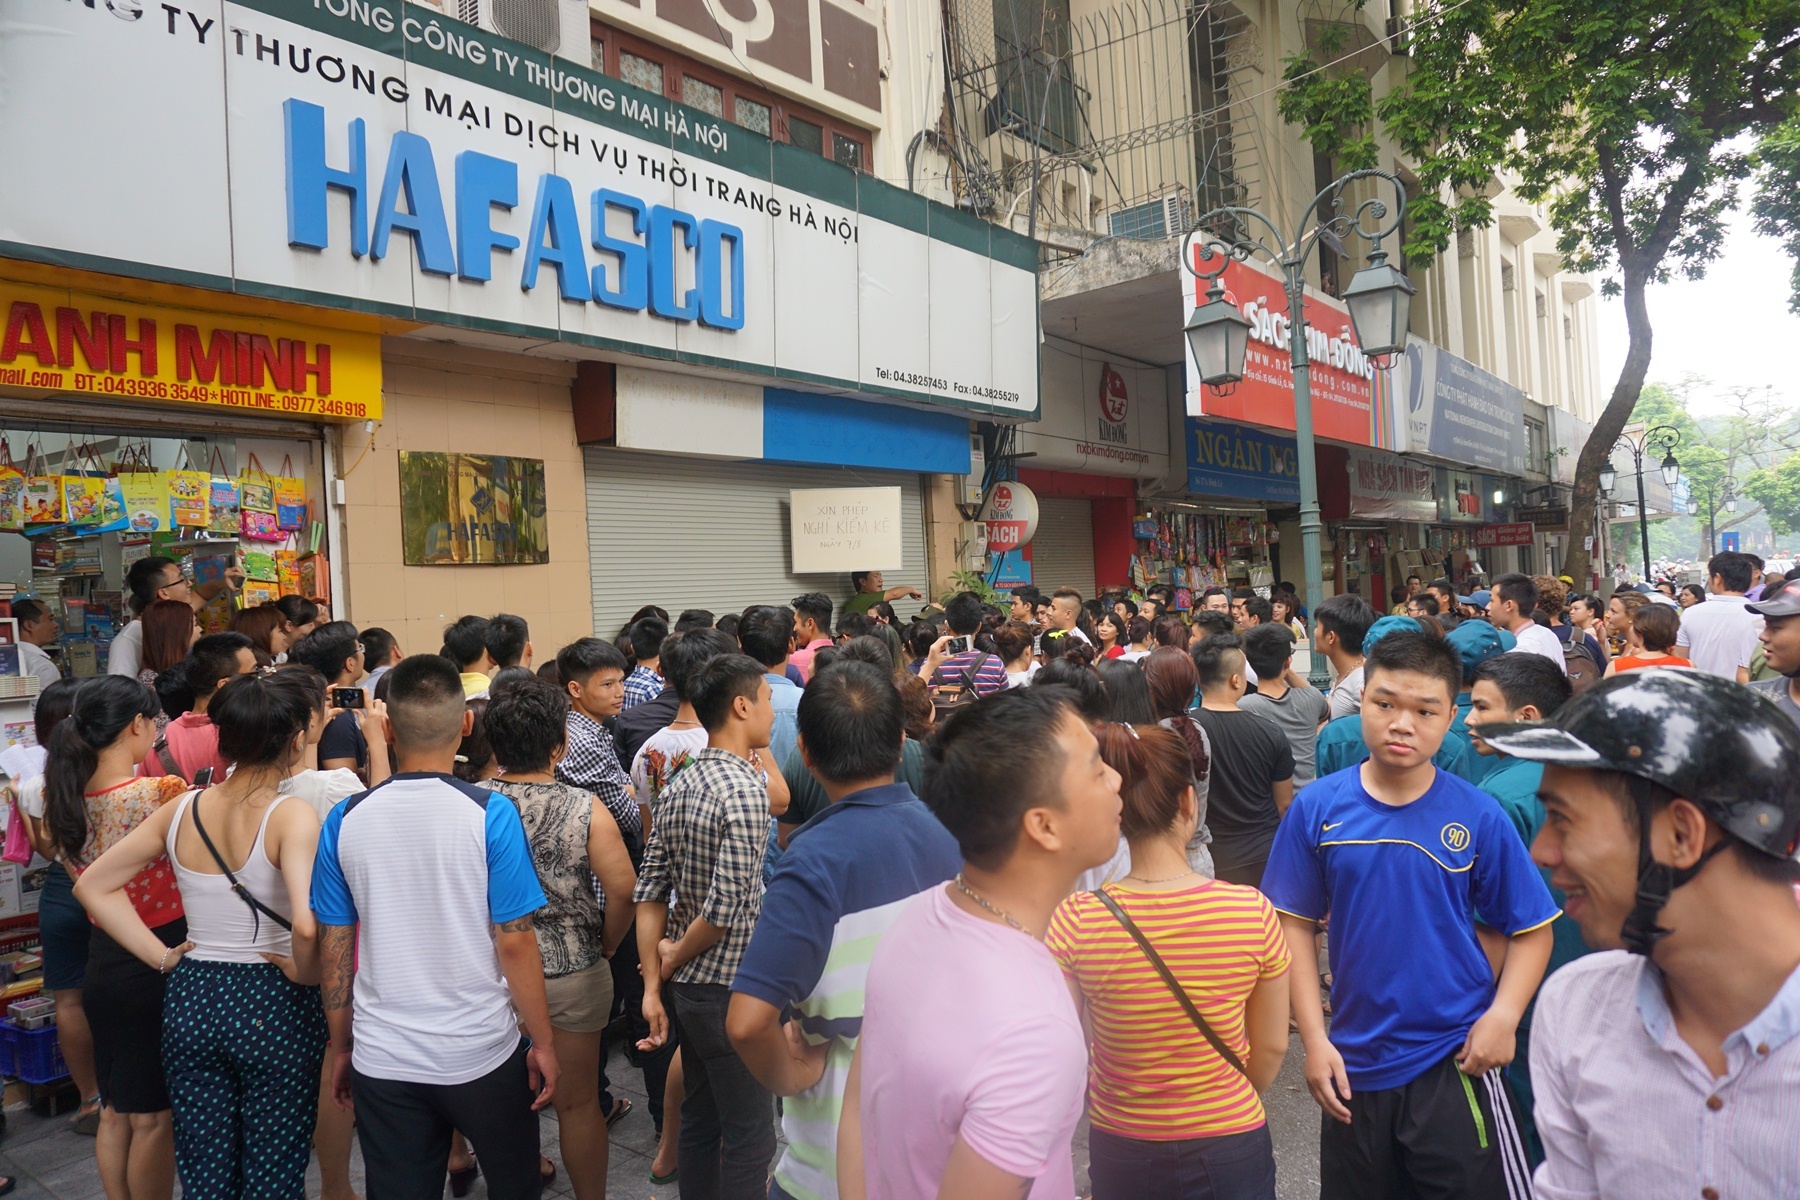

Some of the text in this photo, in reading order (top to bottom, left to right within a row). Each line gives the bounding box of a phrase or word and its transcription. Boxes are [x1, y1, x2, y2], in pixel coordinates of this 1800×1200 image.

[402, 17, 487, 65] CÔNG
[492, 48, 519, 77] TY
[524, 59, 615, 112] THƯƠNG
[621, 94, 659, 130] MẠI
[664, 109, 691, 139] HÀ
[695, 123, 729, 154] NỘI
[161, 3, 214, 44] TY
[230, 24, 409, 104] THƯƠNG
[425, 87, 490, 130] MẠI
[505, 112, 579, 156] DỊCH
[591, 139, 628, 175] VỤ
[637, 154, 698, 192] THỜI
[706, 176, 782, 218] TRANG
[790, 203, 818, 231] HÀ
[824, 216, 859, 244] NỘI
[283, 97, 746, 331] HAFASCO
[0, 301, 332, 397] ANH MINH
[1330, 325, 1373, 381] ĐỒNG
[1195, 428, 1262, 473] NGÂN
[1408, 419, 1427, 435] VNPT
[842, 501, 869, 516] PHÉP
[1477, 525, 1497, 545] SÁCH
[1448, 827, 1464, 848] 90
